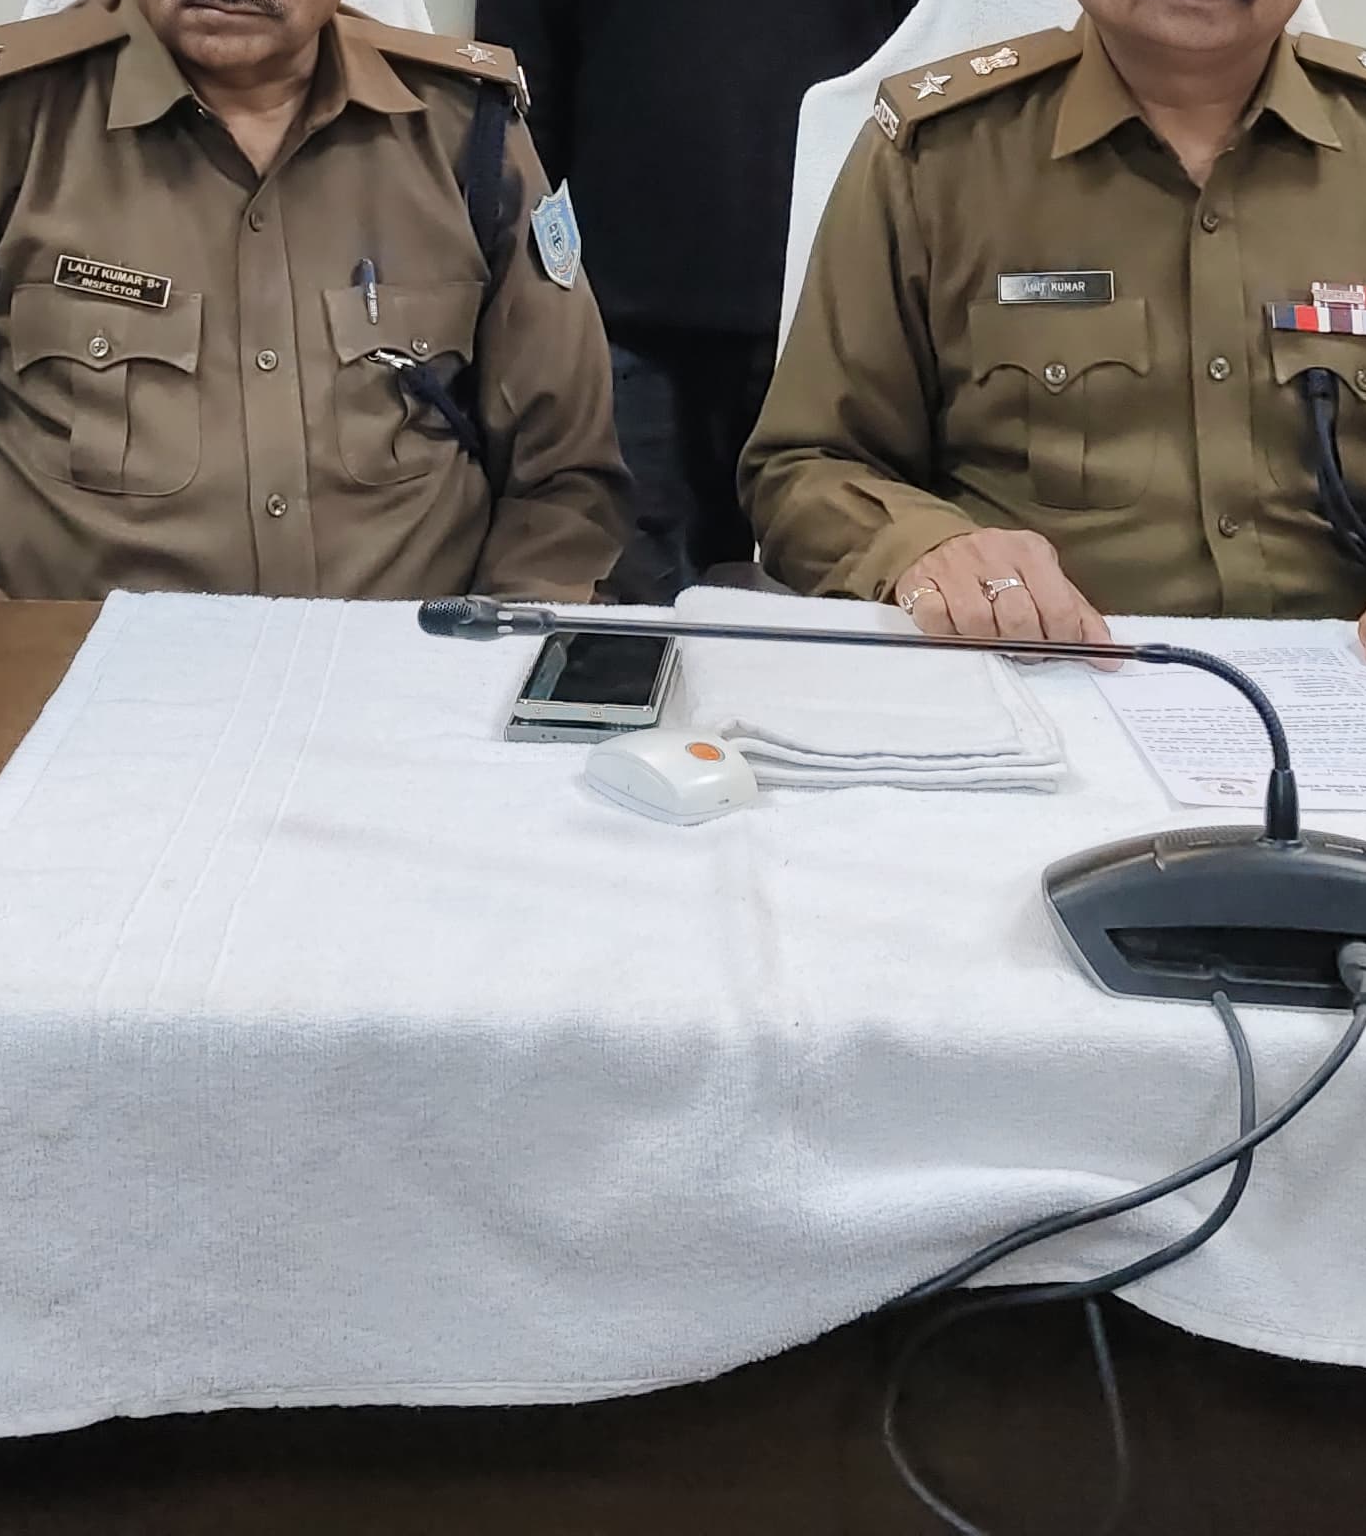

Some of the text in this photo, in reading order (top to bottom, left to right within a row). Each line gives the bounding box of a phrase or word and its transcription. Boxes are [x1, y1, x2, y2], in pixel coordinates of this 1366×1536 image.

[67, 261, 101, 275] LALIT
[101, 268, 143, 286] KUMAR
[81, 277, 142, 298] INSPECTOR
[1050, 280, 1086, 293] KUMAR
